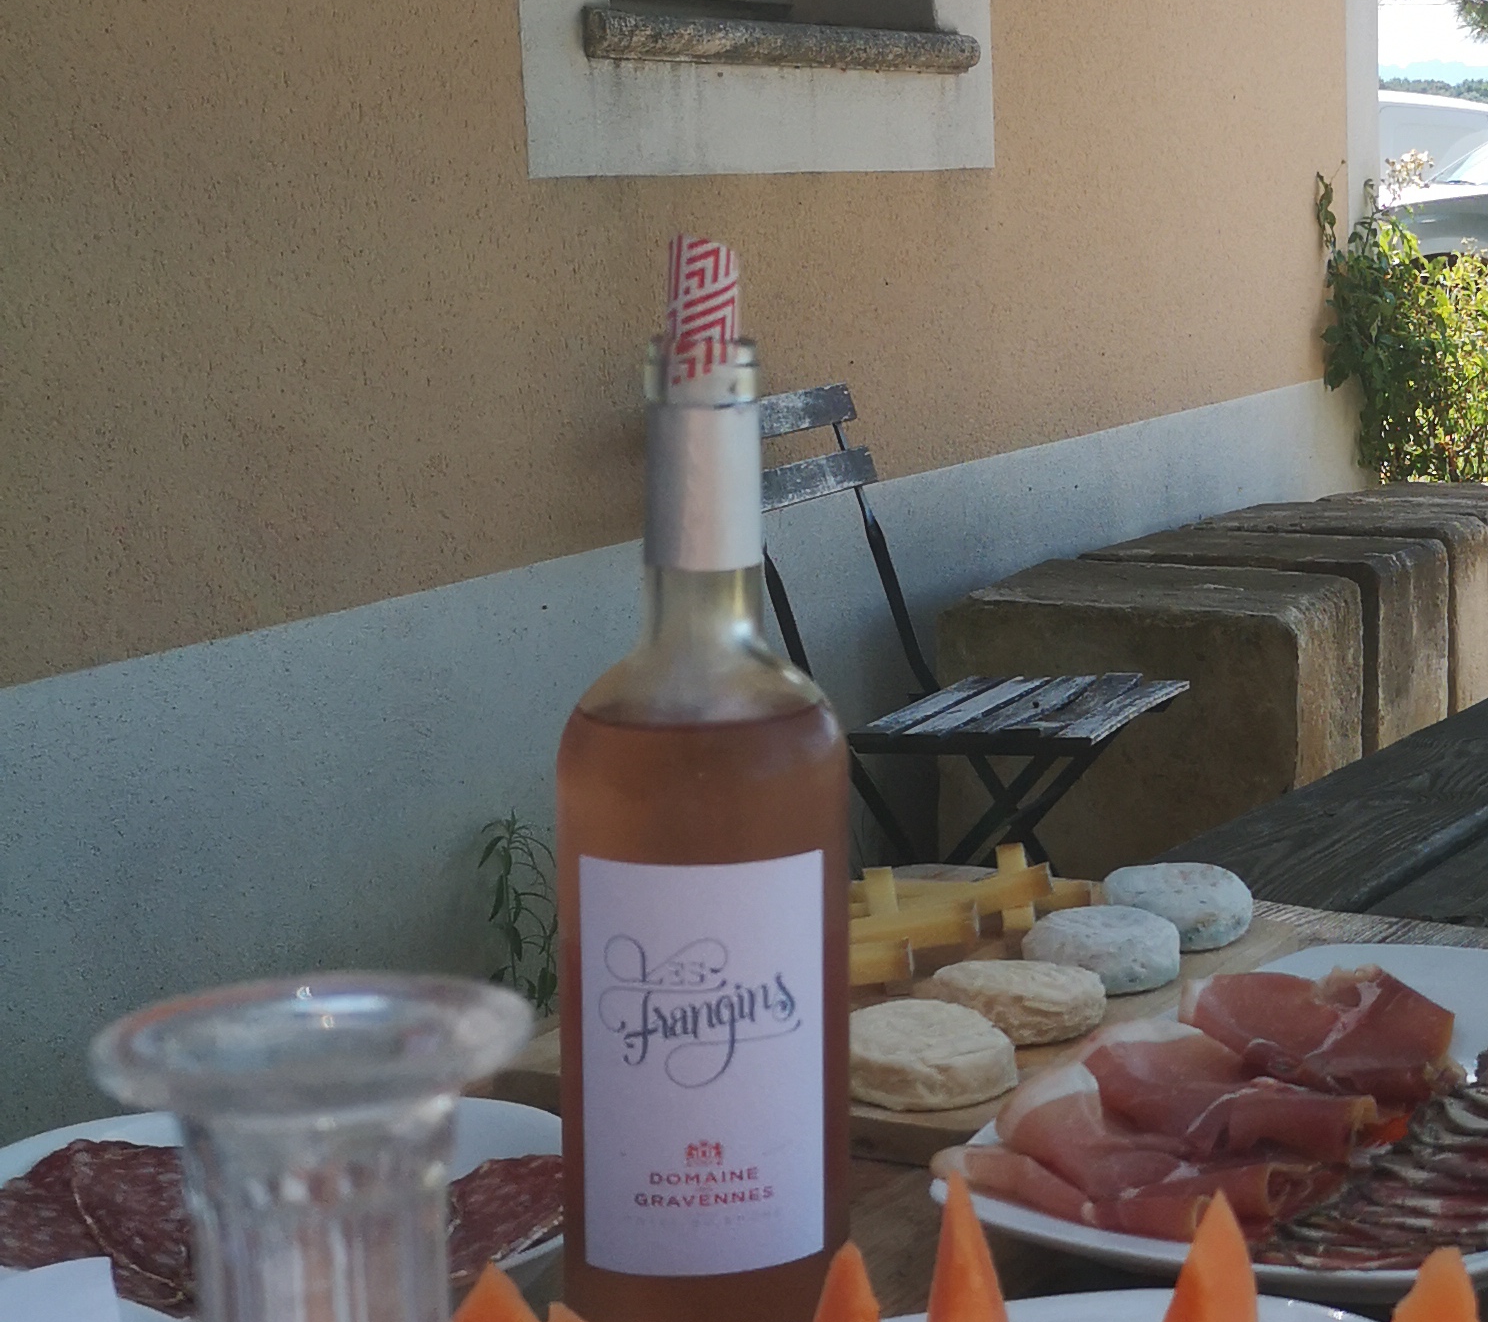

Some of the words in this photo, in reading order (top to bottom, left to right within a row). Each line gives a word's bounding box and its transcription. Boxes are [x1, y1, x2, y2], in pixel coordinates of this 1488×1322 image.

[598, 971, 801, 1088] Frangins
[649, 1166, 758, 1185] DOMAINE
[634, 1186, 775, 1208] GRAVENNES
